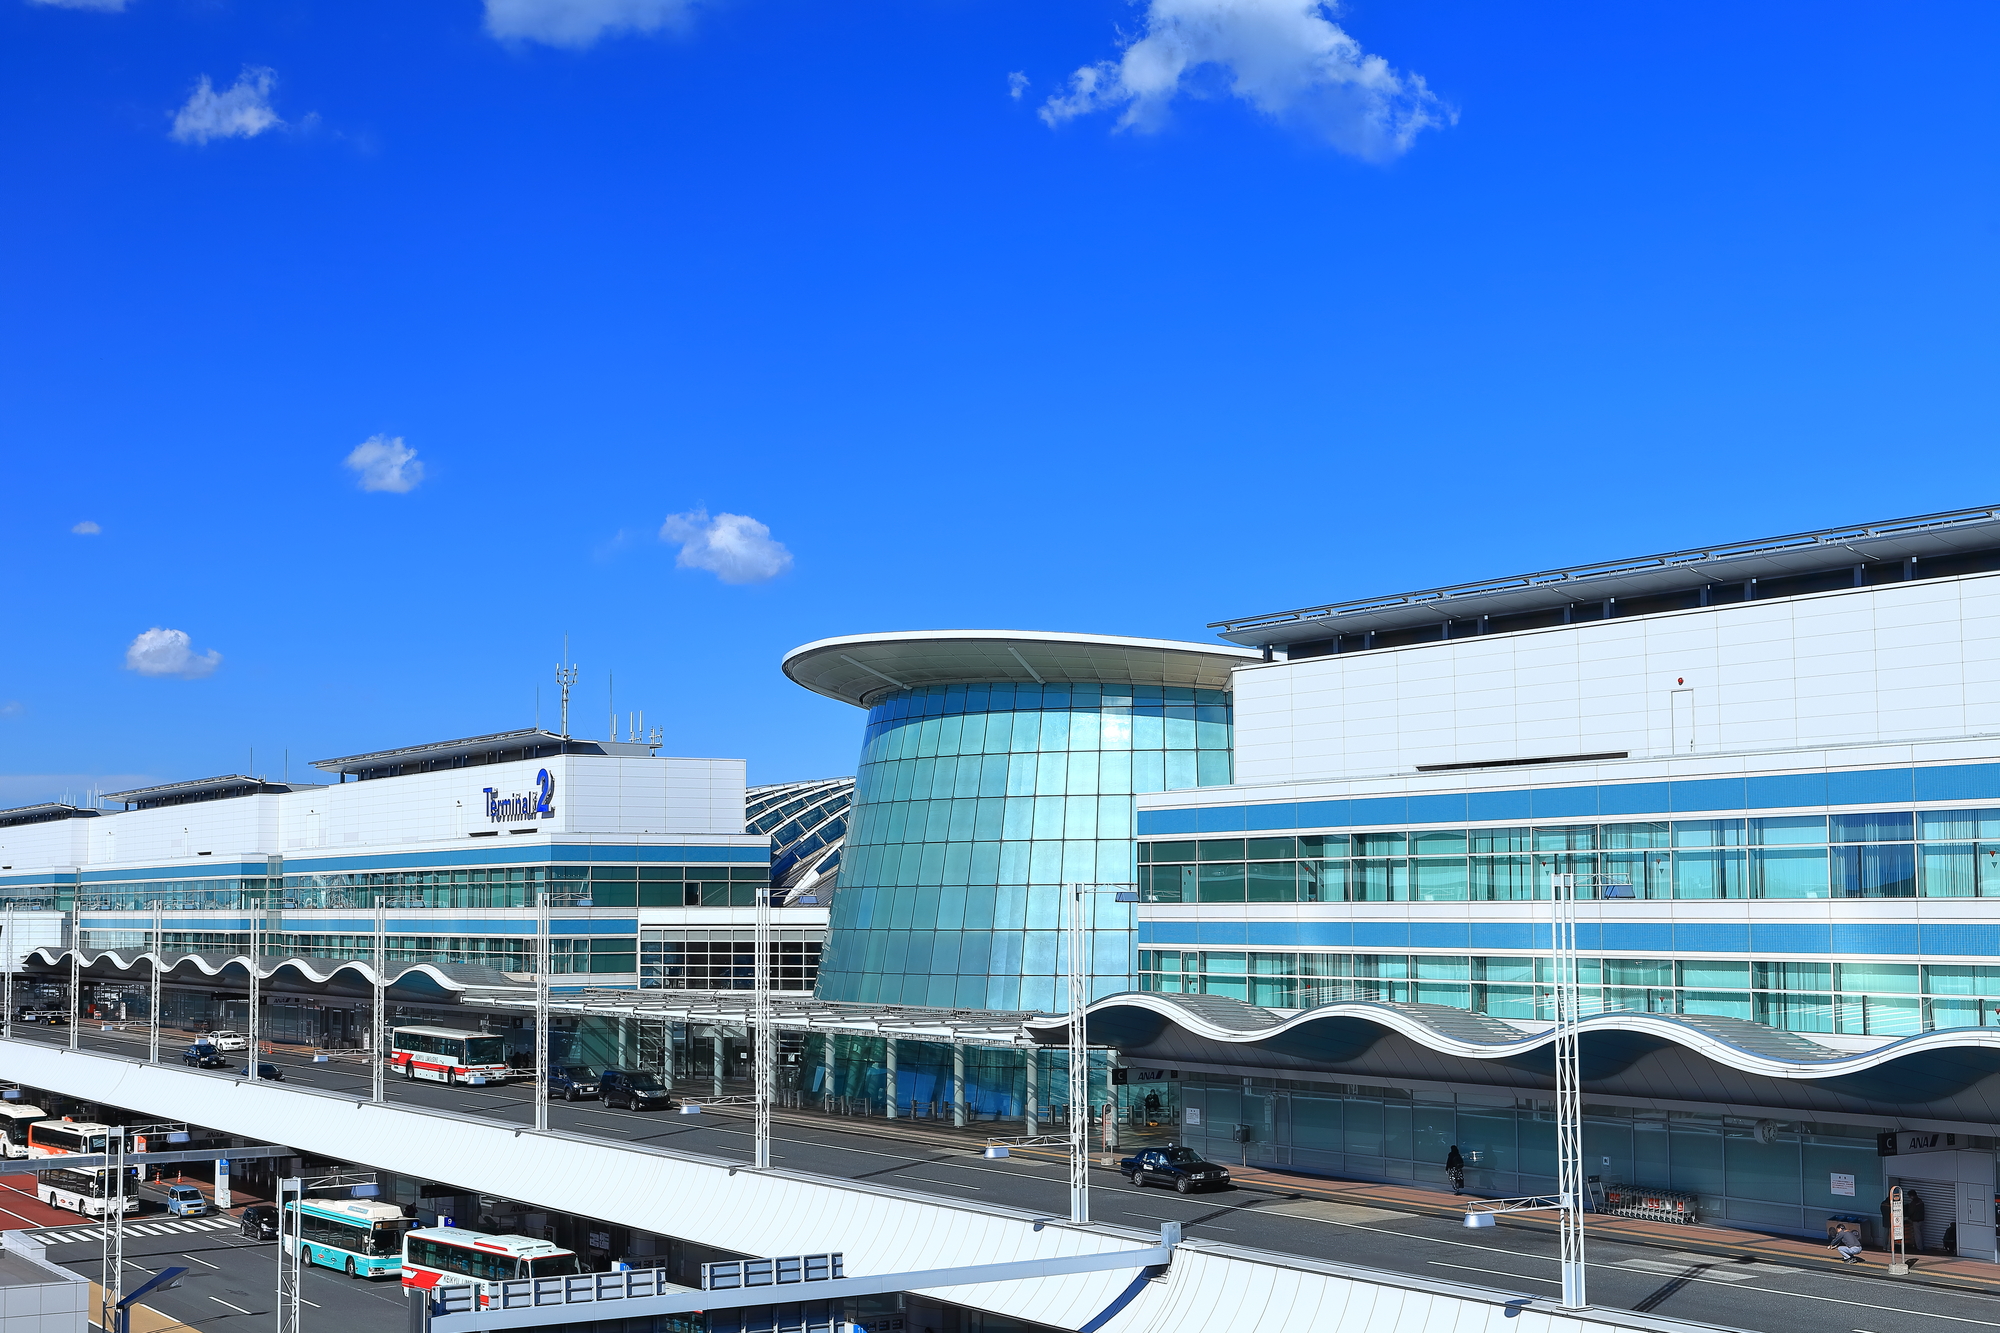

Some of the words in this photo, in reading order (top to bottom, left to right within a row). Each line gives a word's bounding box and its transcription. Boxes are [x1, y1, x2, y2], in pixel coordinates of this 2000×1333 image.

[483, 787, 531, 817] Terminal
[536, 768, 549, 812] 2
[1118, 1072, 1123, 1080] C
[1137, 1071, 1156, 1081] ANA
[1886, 1138, 1893, 1149] C
[1908, 1136, 1929, 1150] ANA
[510, 1205, 528, 1213] ANA
[444, 1275, 459, 1285] KEIKYU
